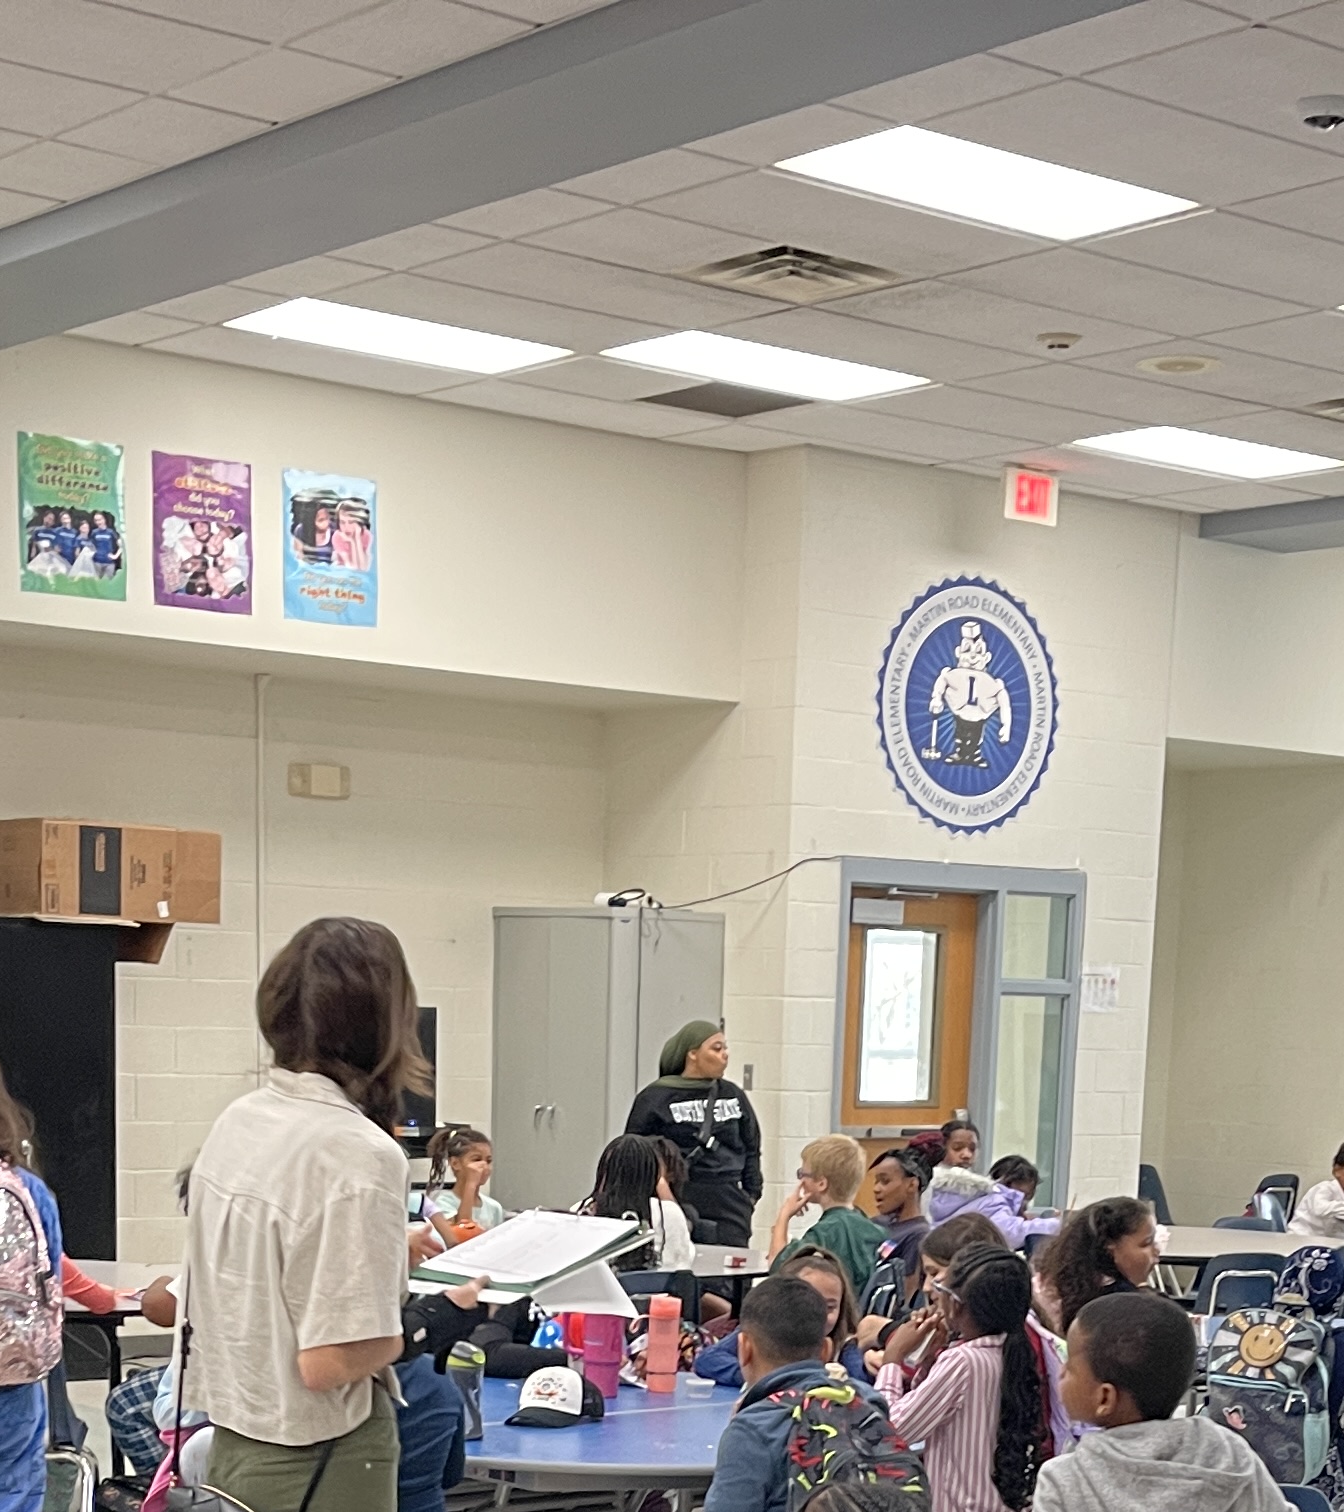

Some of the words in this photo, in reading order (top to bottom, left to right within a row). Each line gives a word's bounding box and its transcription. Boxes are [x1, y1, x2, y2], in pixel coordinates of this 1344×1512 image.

[36, 475, 109, 491] difference
[44, 463, 101, 477] positive
[1016, 475, 1052, 518] EXIT
[300, 585, 331, 599] right
[335, 588, 365, 604] thing
[909, 600, 947, 641] MARTIN
[947, 594, 979, 612] ROAD
[981, 597, 1038, 661] ELEMENTARY
[888, 650, 909, 747] ELEMENTARY
[968, 676, 978, 706] L
[1032, 670, 1047, 726] MARTIN
[896, 747, 920, 787] ROAD
[1025, 725, 1047, 772] ROAD
[918, 780, 960, 816] MARTIN
[965, 770, 1028, 818] ELEMENTARY
